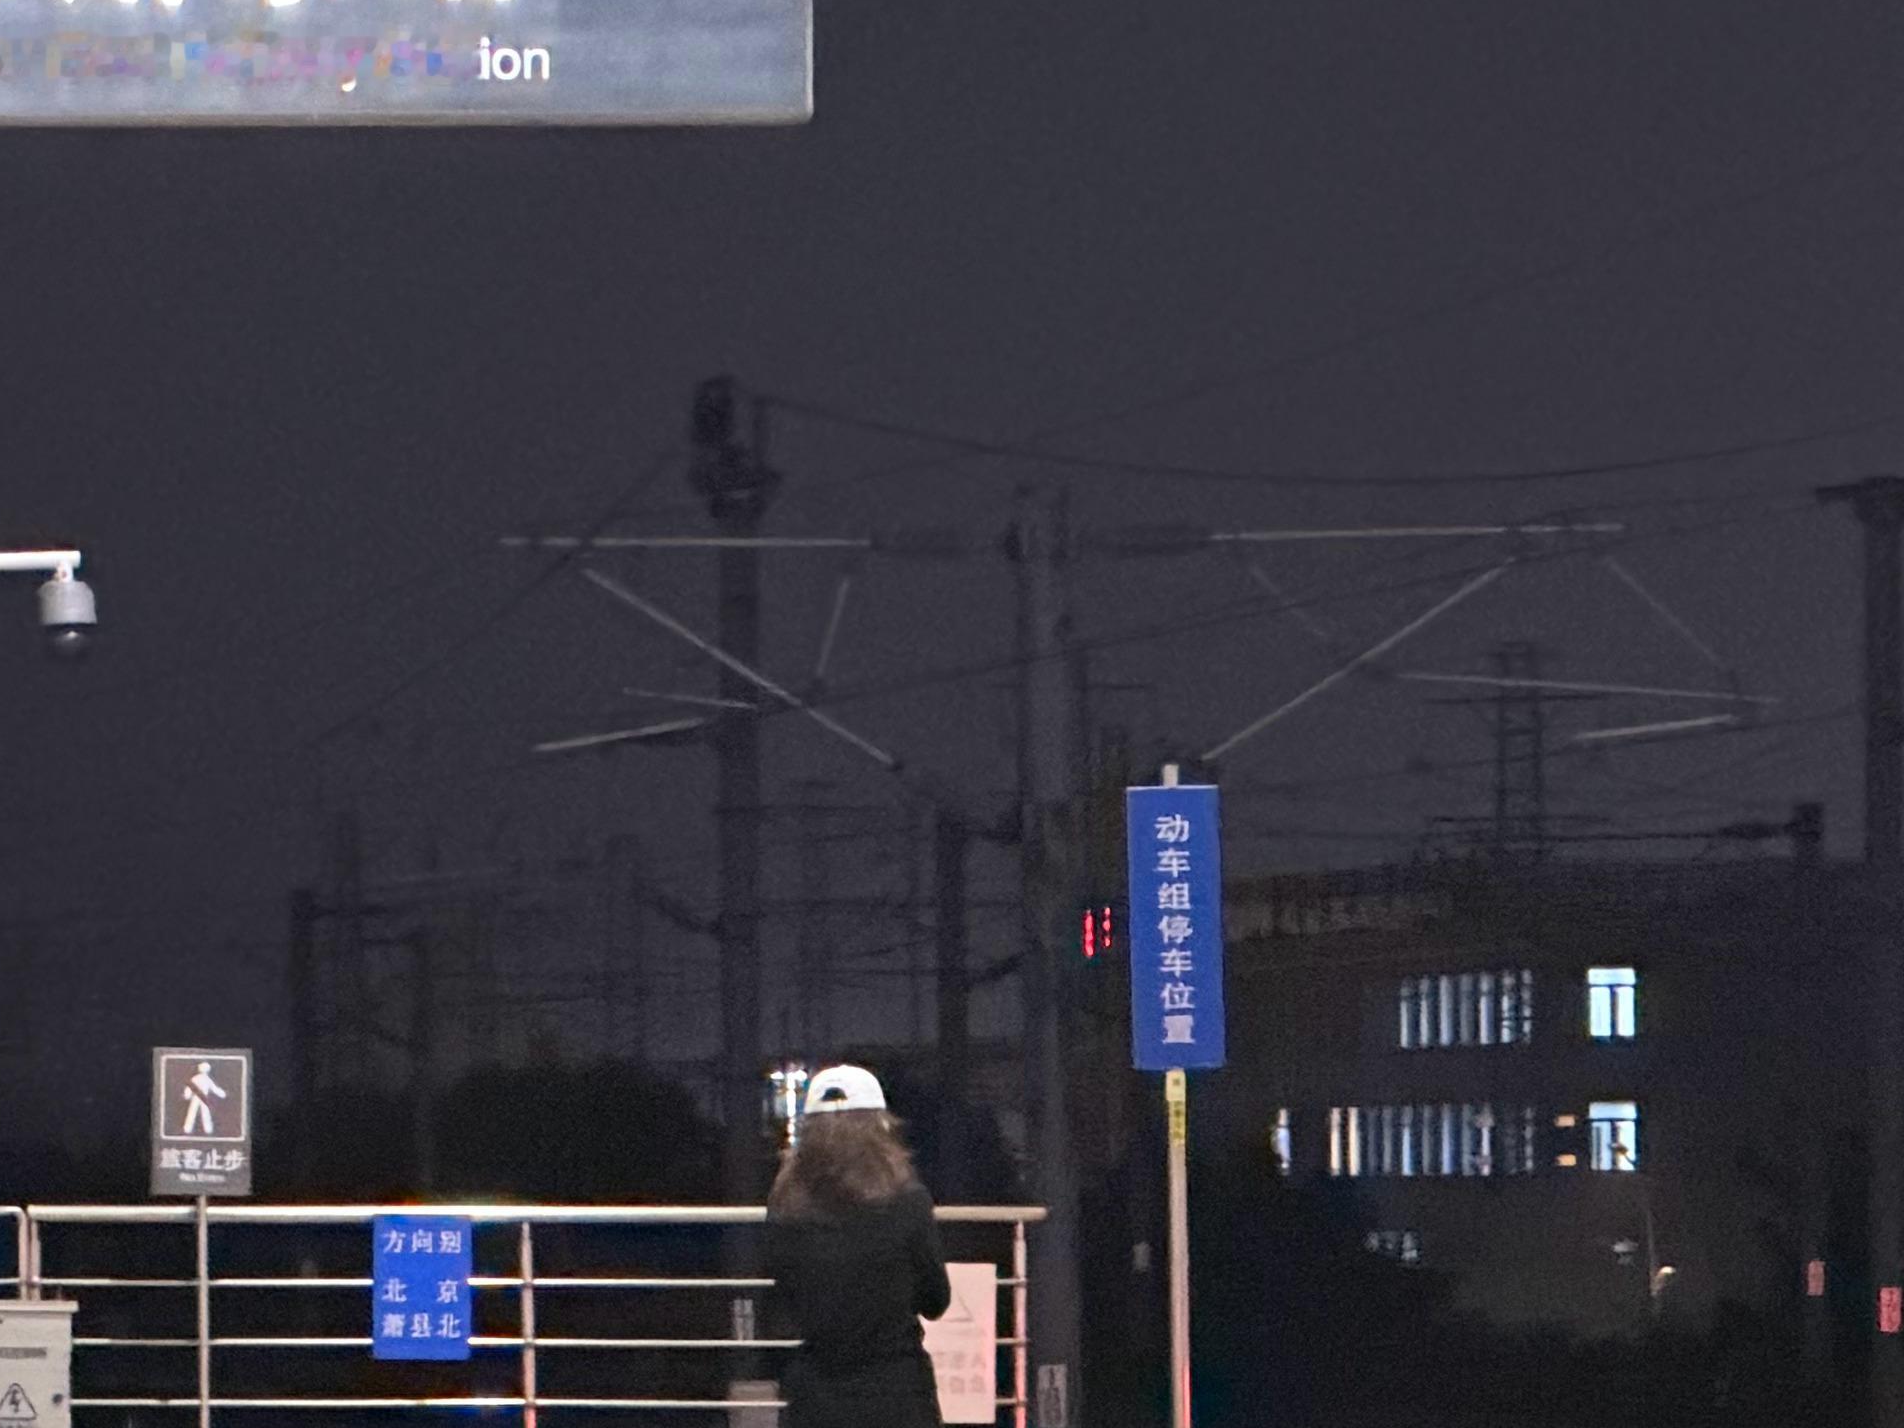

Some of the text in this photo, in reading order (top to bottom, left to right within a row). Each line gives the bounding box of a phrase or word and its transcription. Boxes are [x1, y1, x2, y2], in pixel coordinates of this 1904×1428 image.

[1154, 814, 1195, 1045] 动车组停车位置
[382, 1229, 462, 1254] 方向别
